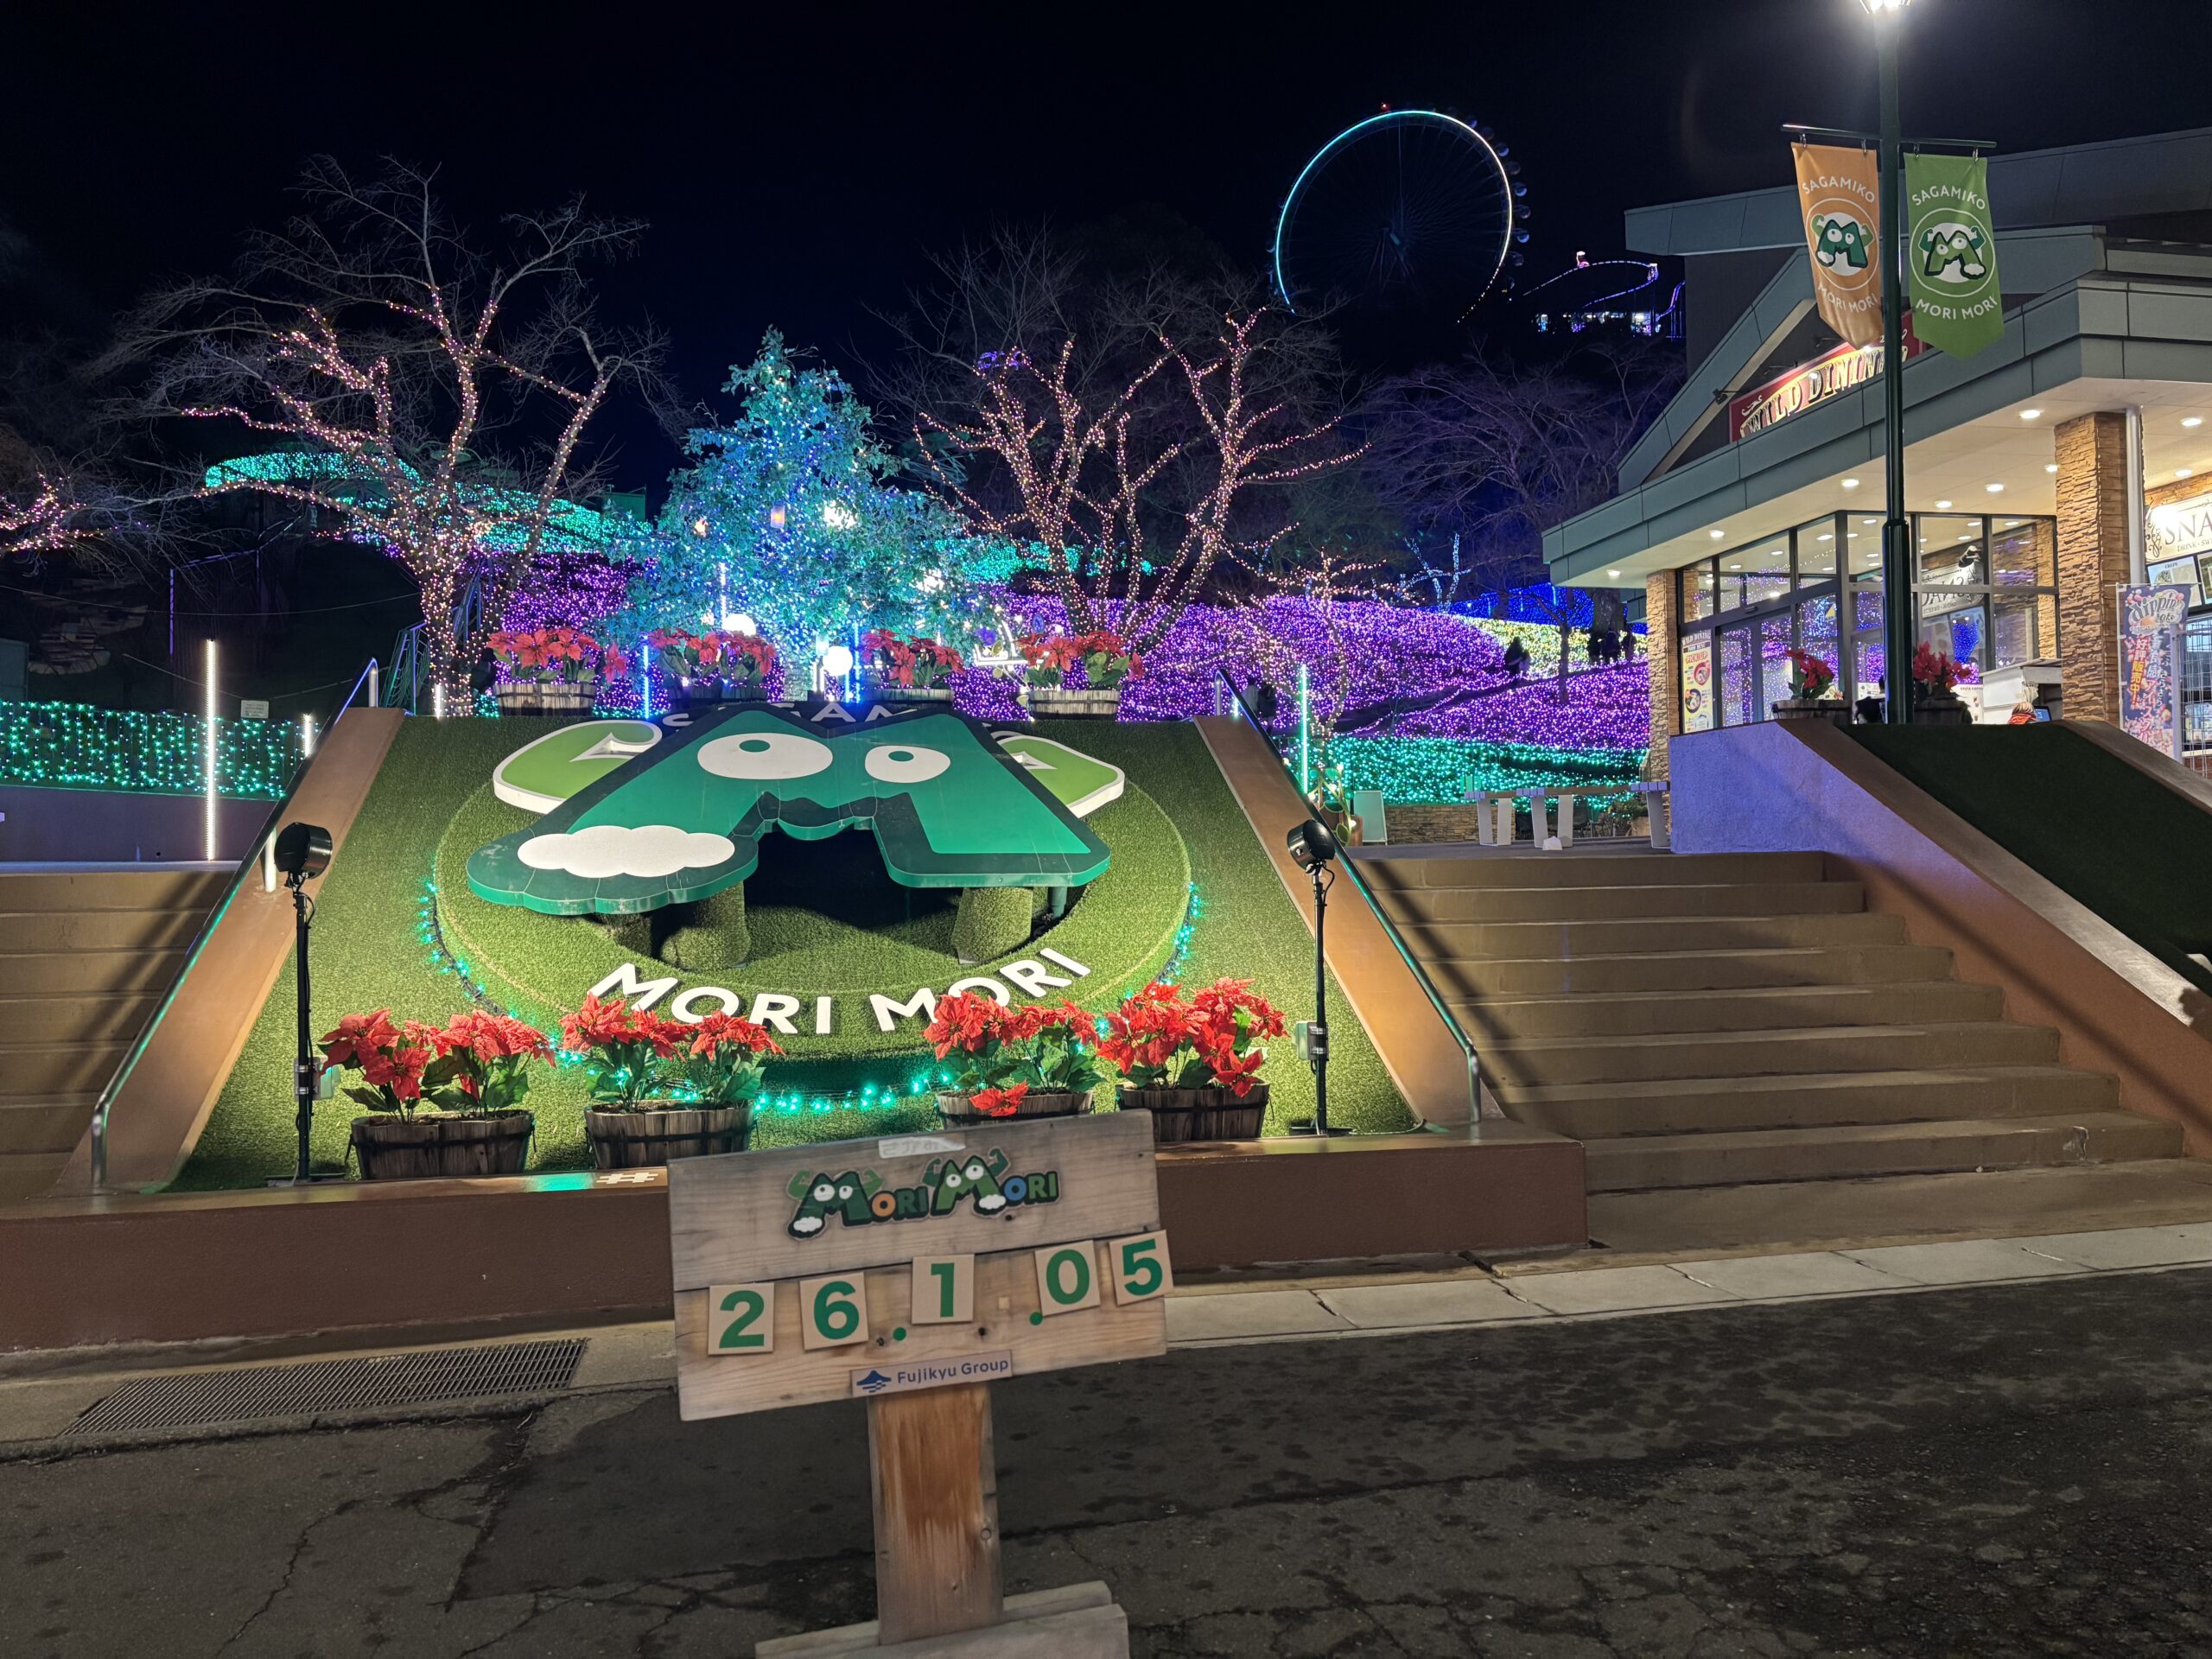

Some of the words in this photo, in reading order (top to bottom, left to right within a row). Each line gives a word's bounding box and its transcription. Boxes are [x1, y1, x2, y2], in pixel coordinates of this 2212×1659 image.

[1802, 175, 1875, 203] SAGAMIKO
[1911, 184, 1986, 210] SAGAMIKO
[1817, 283, 1847, 311] MORI
[1848, 292, 1878, 313] MORI
[1916, 298, 1956, 320] MORI
[1961, 296, 1998, 320] MORI
[1746, 383, 1802, 434] WILD
[587, 962, 831, 1035] MORI
[869, 948, 1091, 1033] MORI
[787, 1169, 929, 1239] MORI
[930, 1154, 1060, 1216] MORI
[897, 1362, 957, 1386] Fujikyu
[962, 1357, 1009, 1378] Group
